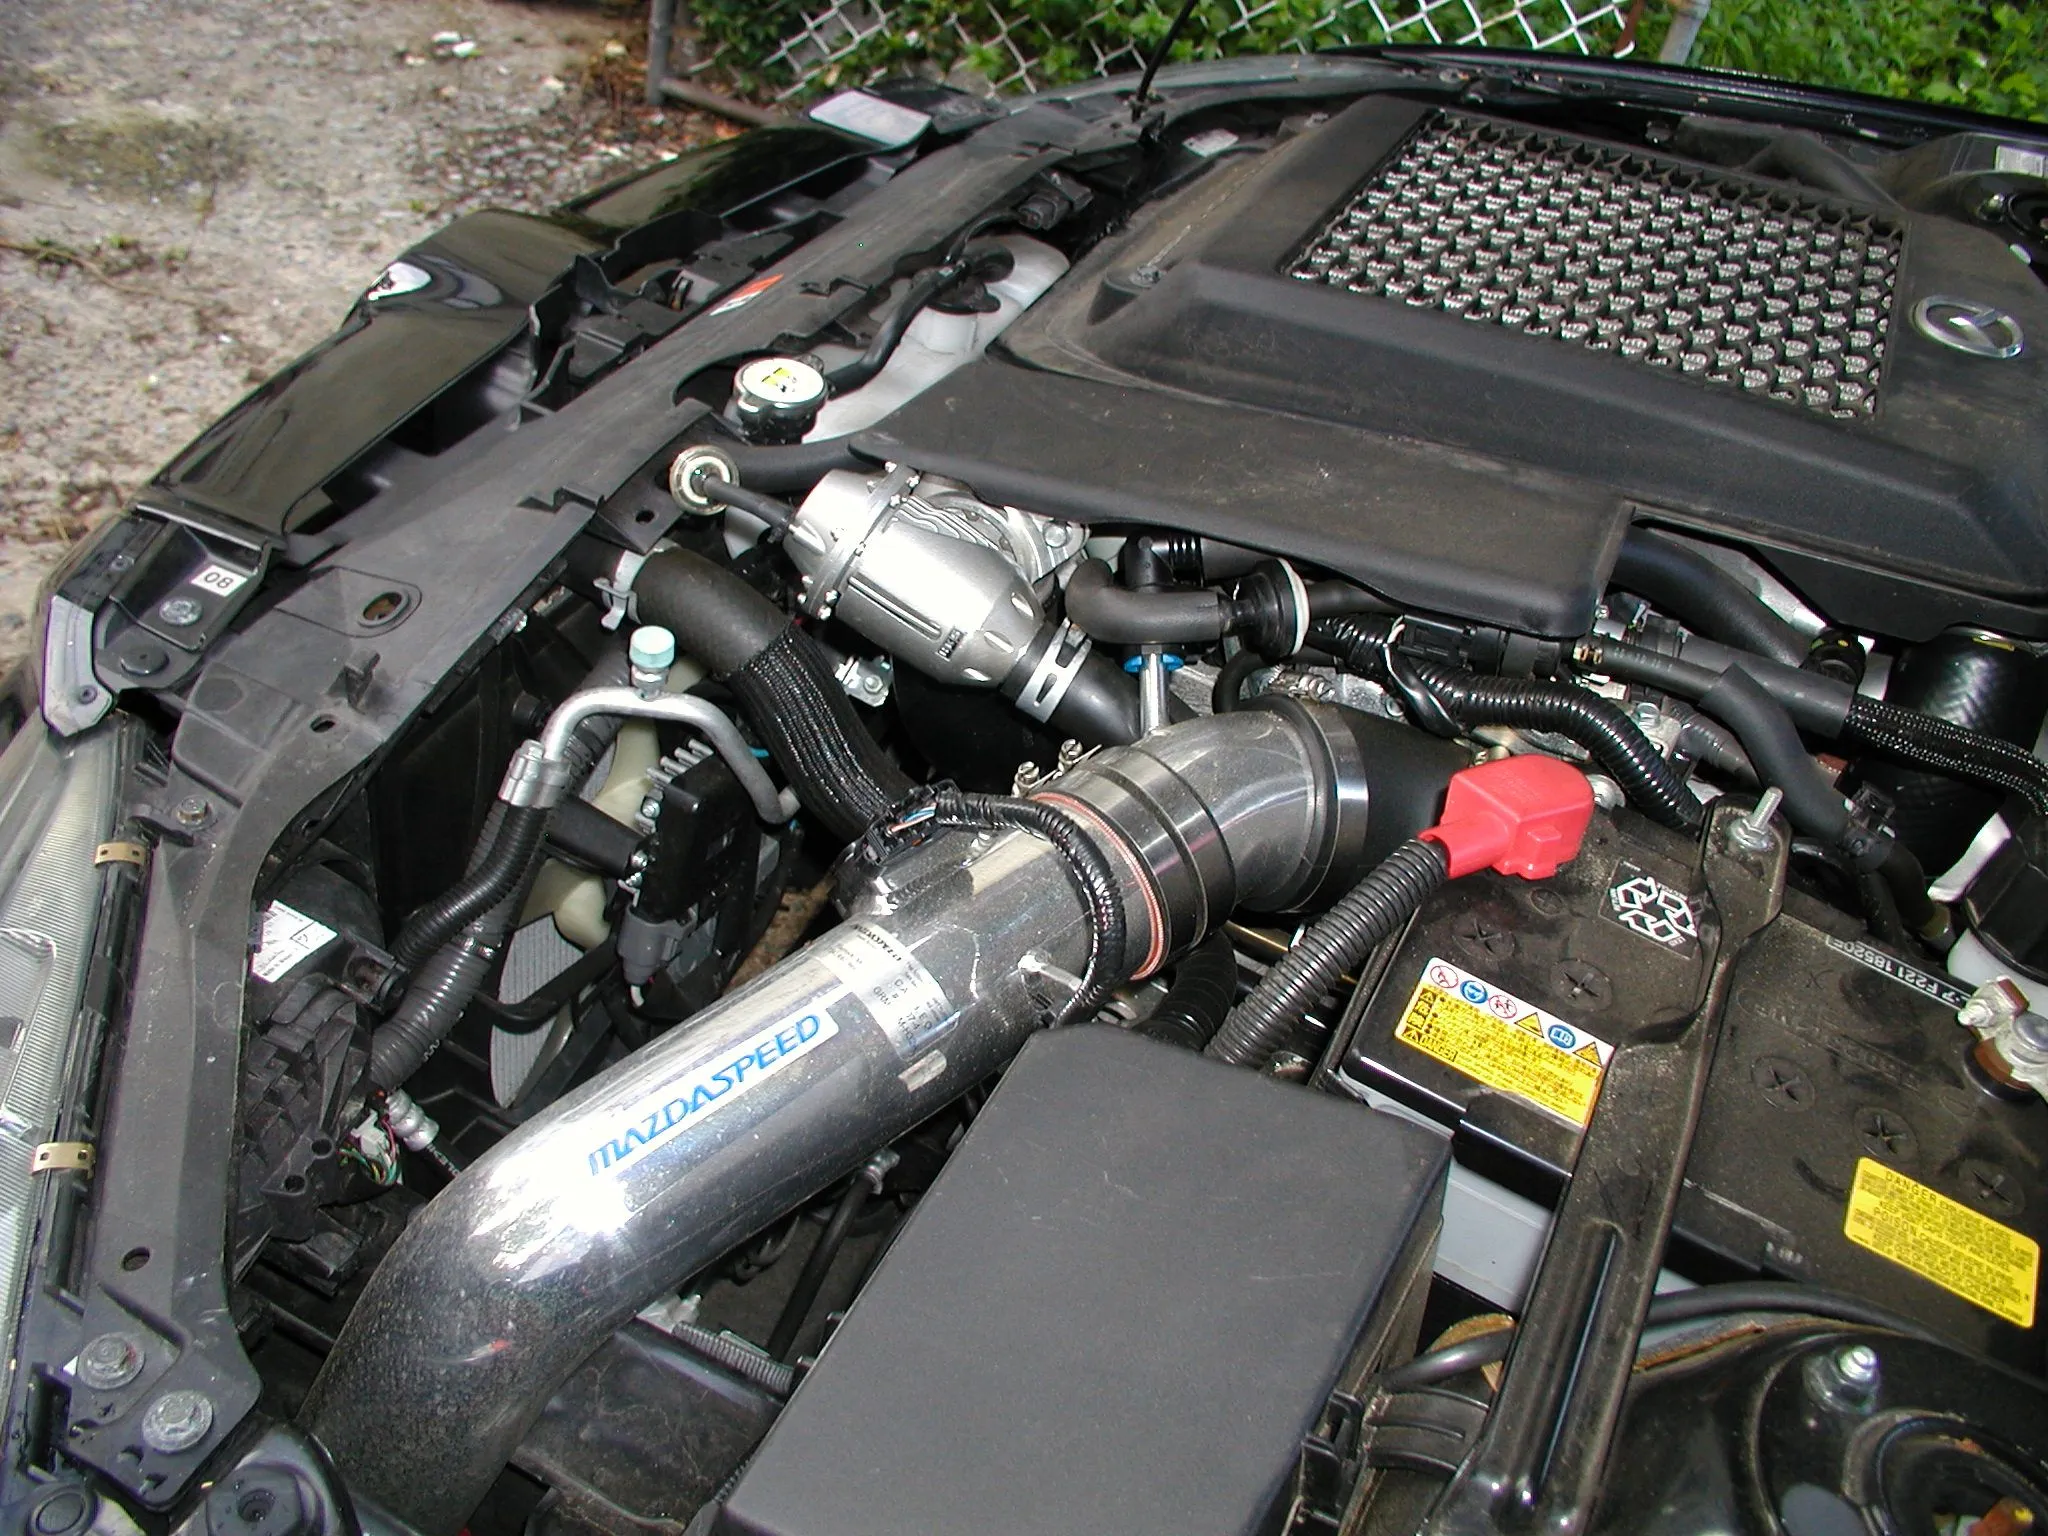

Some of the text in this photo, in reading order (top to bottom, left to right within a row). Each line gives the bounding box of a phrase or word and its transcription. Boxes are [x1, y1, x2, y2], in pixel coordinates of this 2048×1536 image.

[203, 571, 235, 590] 08
[1897, 965, 1940, 995] F221
[1421, 1031, 1458, 1061] DANGER
[587, 1013, 822, 1176] MAZDASPEED
[1885, 1170, 1938, 1203] DANGER
[1873, 1206, 1918, 1236] POISON
